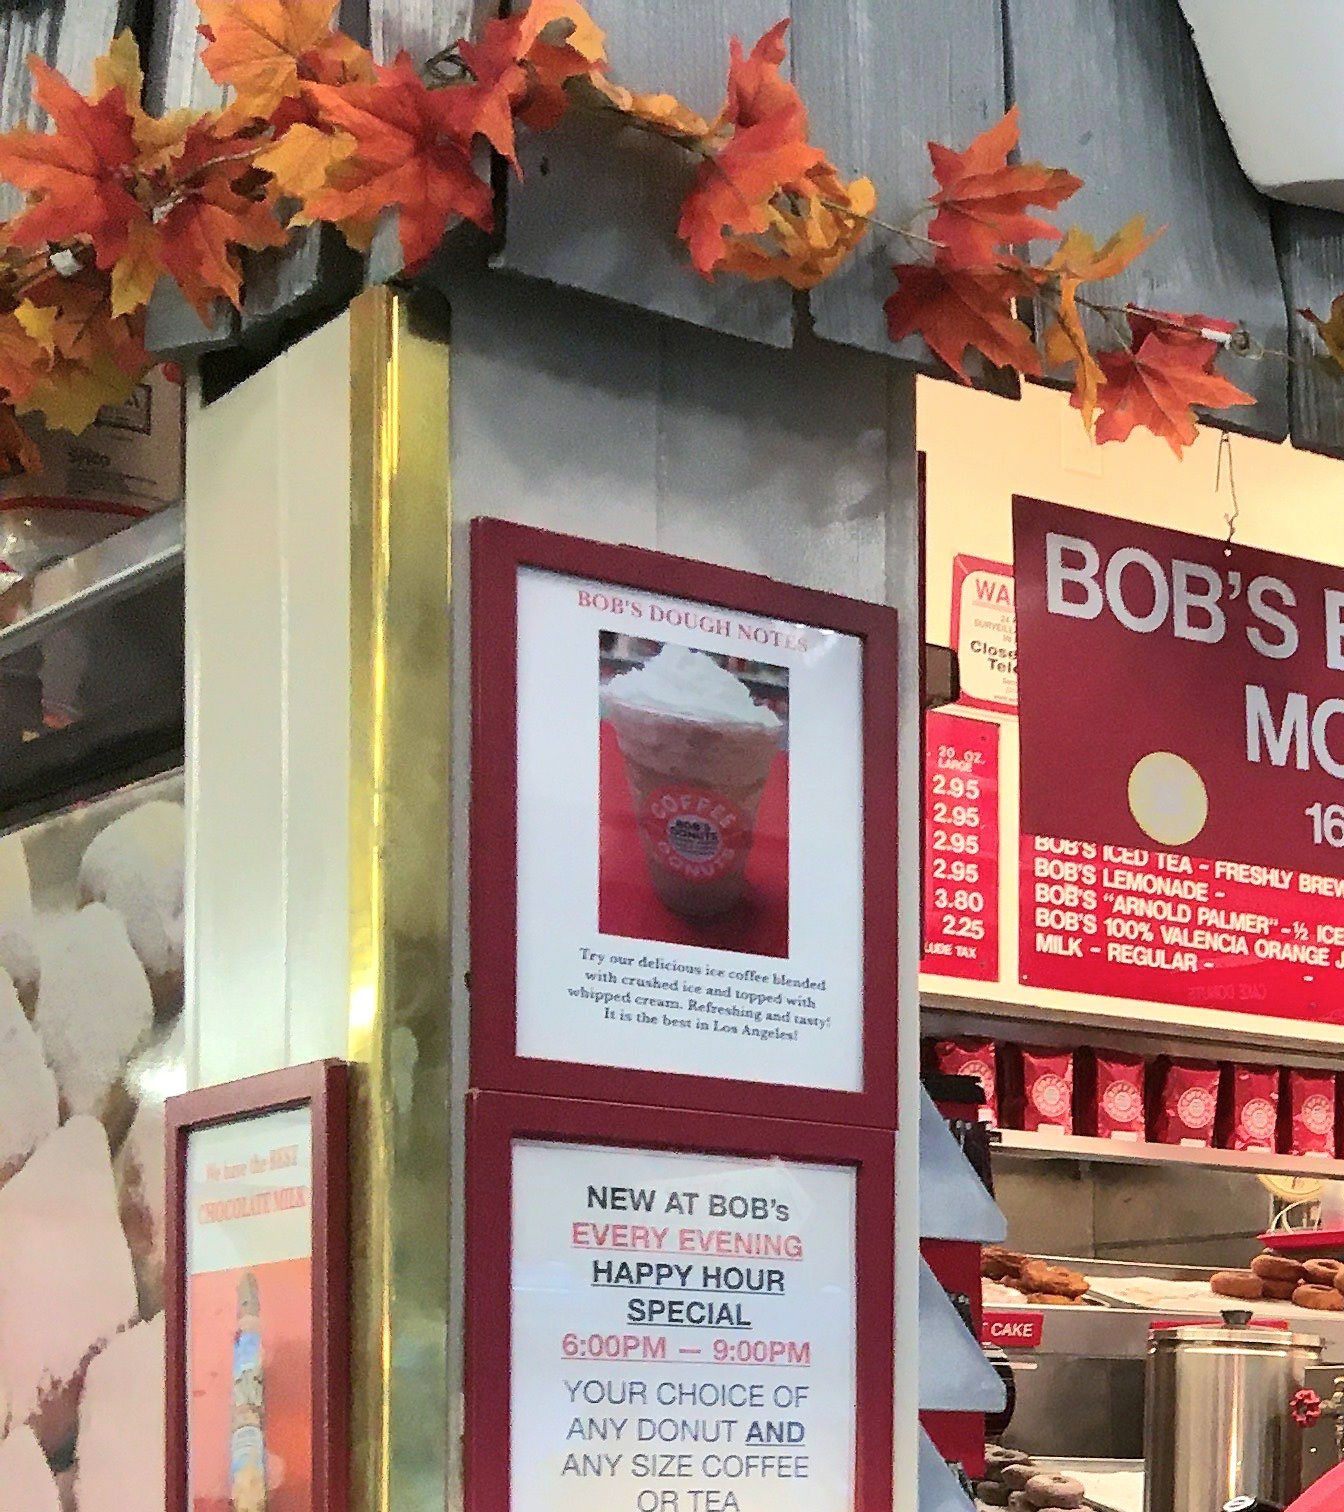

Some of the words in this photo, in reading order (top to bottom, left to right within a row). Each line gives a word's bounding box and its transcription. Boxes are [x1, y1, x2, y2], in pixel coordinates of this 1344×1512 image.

[1045, 531, 1300, 660] BOB'S
[576, 589, 643, 618] BOB'S
[649, 603, 732, 638] DOUGH
[932, 774, 981, 800] 2.95
[932, 802, 980, 828] 2.95
[932, 829, 980, 855] 2.95
[932, 857, 980, 883] 2.95
[1033, 857, 1097, 886] BOB'S
[1102, 867, 1210, 903] LEMONADE
[1156, 852, 1194, 875] TEA
[1214, 860, 1293, 891] FRESHLY
[934, 887, 985, 913] 3.80
[1033, 882, 1098, 912] BOB'S
[942, 914, 986, 940] 2.25
[1034, 908, 1098, 936] BOB'S
[1102, 917, 1155, 944] 100%
[1160, 924, 1249, 957] VALENCIA
[1253, 937, 1331, 968] ORANGE
[579, 946, 605, 966] Try
[609, 954, 635, 968] our
[638, 955, 702, 976] delicious
[728, 969, 770, 985] coffee
[772, 972, 827, 992] blended
[1034, 933, 1083, 958] MILK
[1106, 943, 1199, 974] REGULAR
[567, 986, 632, 1005] whipped
[687, 998, 763, 1023] Refreshing
[765, 1009, 791, 1024] and
[584, 969, 618, 986] with
[621, 975, 679, 993] crushed
[705, 983, 733, 998] and
[735, 989, 784, 1008] topped
[786, 993, 817, 1010] with
[635, 1010, 659, 1026] the
[662, 1014, 693, 1029] best
[713, 1020, 739, 1034] Los
[586, 1184, 656, 1214] NEW
[664, 1191, 700, 1216] AT
[707, 1193, 791, 1222] BOB's
[571, 1221, 668, 1250] EVERY
[678, 1227, 804, 1259] EVENING
[591, 1259, 694, 1288] HAPPY
[701, 1264, 786, 1292] HOUR
[626, 1298, 753, 1327] SPECIAL
[990, 1322, 1034, 1338] CAKE
[561, 1332, 668, 1361] 6:00PM
[711, 1338, 812, 1367] 9:00PM
[563, 1379, 649, 1407] YOUR
[655, 1380, 765, 1409] CHOICE
[773, 1384, 811, 1410] OF
[565, 1417, 628, 1443] ANY
[636, 1418, 739, 1444] DONUT
[744, 1420, 807, 1447] AND
[560, 1453, 624, 1479] ANY
[631, 1453, 695, 1479] SIZE
[701, 1454, 811, 1480] COFFEE
